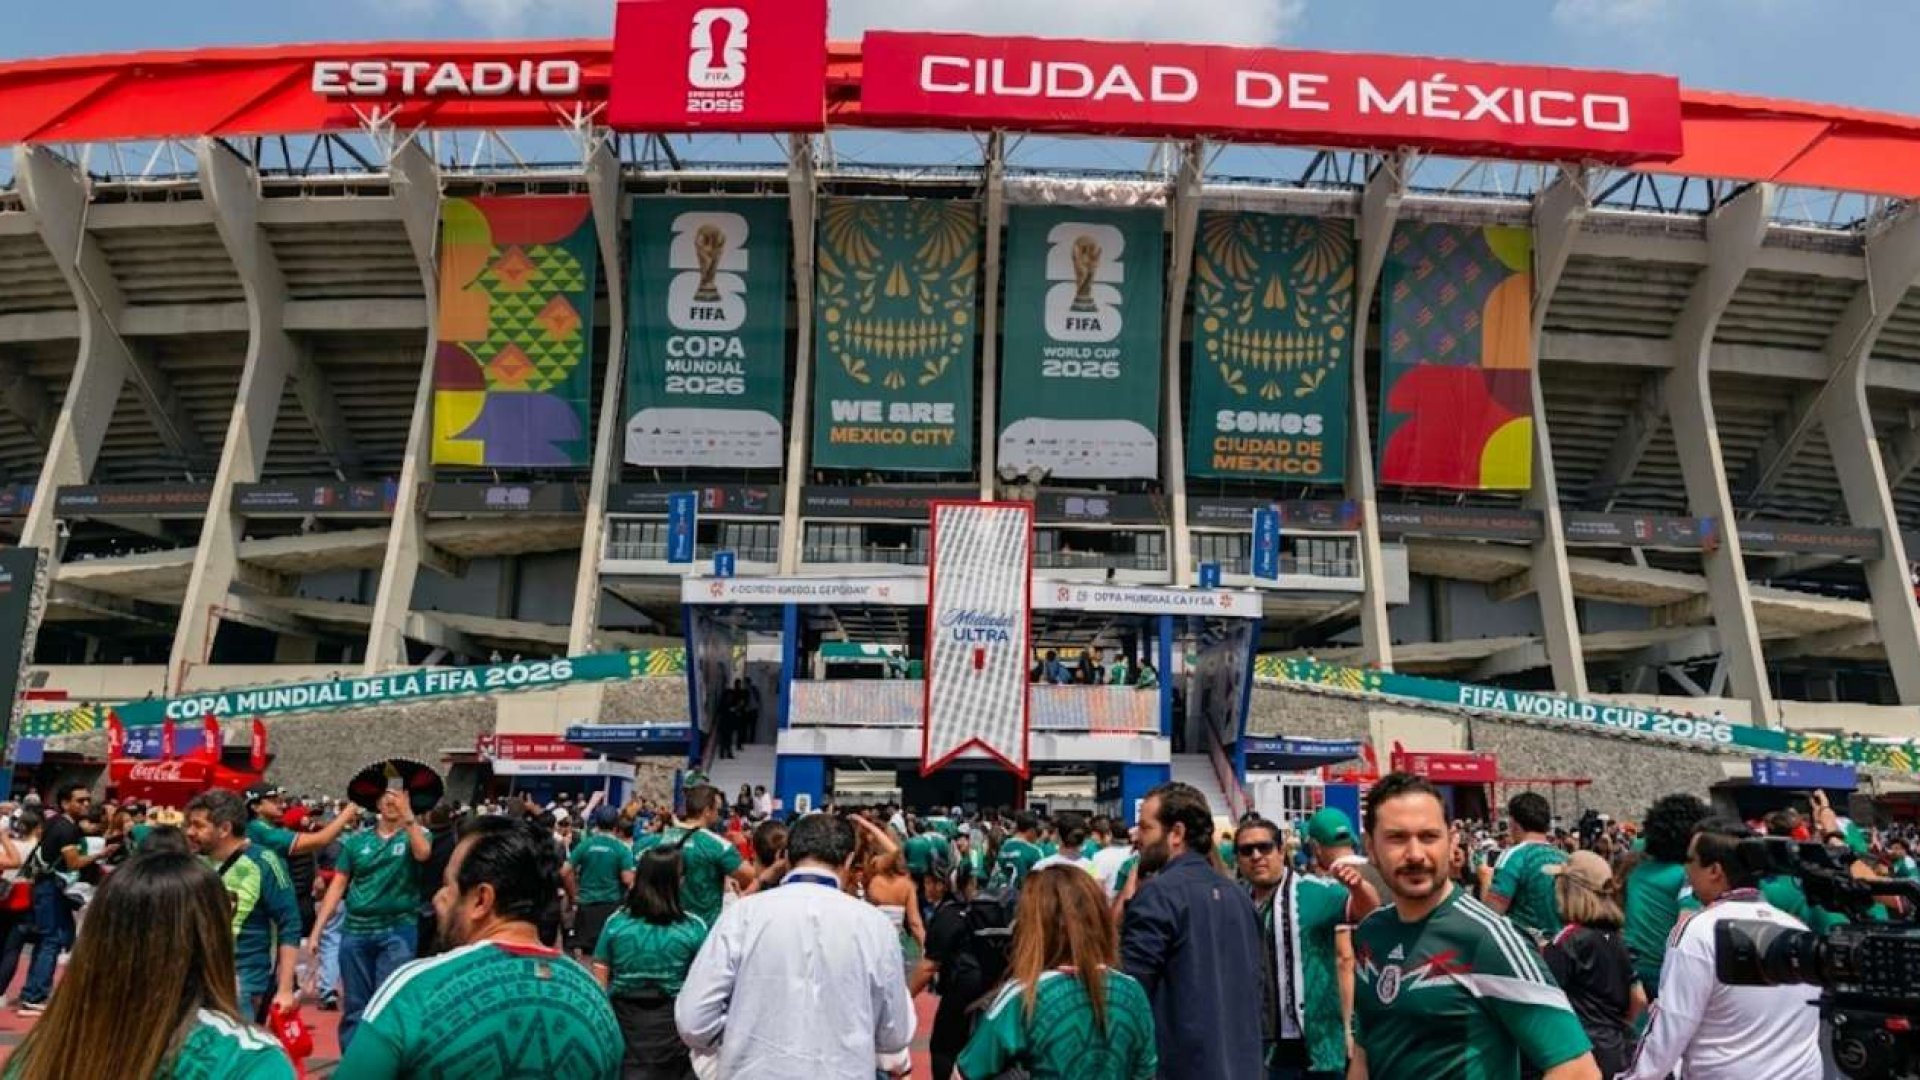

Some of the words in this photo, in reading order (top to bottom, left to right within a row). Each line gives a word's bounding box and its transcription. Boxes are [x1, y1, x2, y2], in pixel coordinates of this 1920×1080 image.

[311, 60, 580, 96] ESTADIO
[919, 55, 1198, 102] CIUDAD
[1235, 70, 1330, 111] DE
[1357, 73, 1630, 132] MÉXICO
[689, 306, 726, 321] FIFA
[1066, 317, 1102, 331] FIFA
[666, 336, 745, 358] COPA
[1043, 346, 1091, 359] WORLD
[1093, 348, 1121, 359] CUP
[665, 359, 745, 375] MUNDIAL
[1042, 360, 1121, 378] 2026
[665, 376, 745, 395] 2026
[831, 399, 882, 422] WE
[888, 402, 955, 424] ARE
[1216, 409, 1323, 436] SOMOS
[830, 427, 907, 444] MEXICO
[911, 429, 955, 445] CITY
[1214, 436, 1291, 455] CIUDAD
[1296, 440, 1322, 457] DE
[1213, 454, 1322, 474] MEXICO
[953, 627, 1008, 641] ULTRA
[166, 695, 231, 719] COPA
[237, 683, 347, 712] MUNDIAL
[352, 680, 383, 699] DE
[390, 676, 420, 694] LA
[426, 670, 477, 692] FIFA
[484, 660, 573, 686] 2026
[1458, 686, 1509, 710] FIFA
[1513, 693, 1597, 722] WORLD
[1602, 708, 1648, 730] CUP
[1651, 714, 1733, 742] 2026
